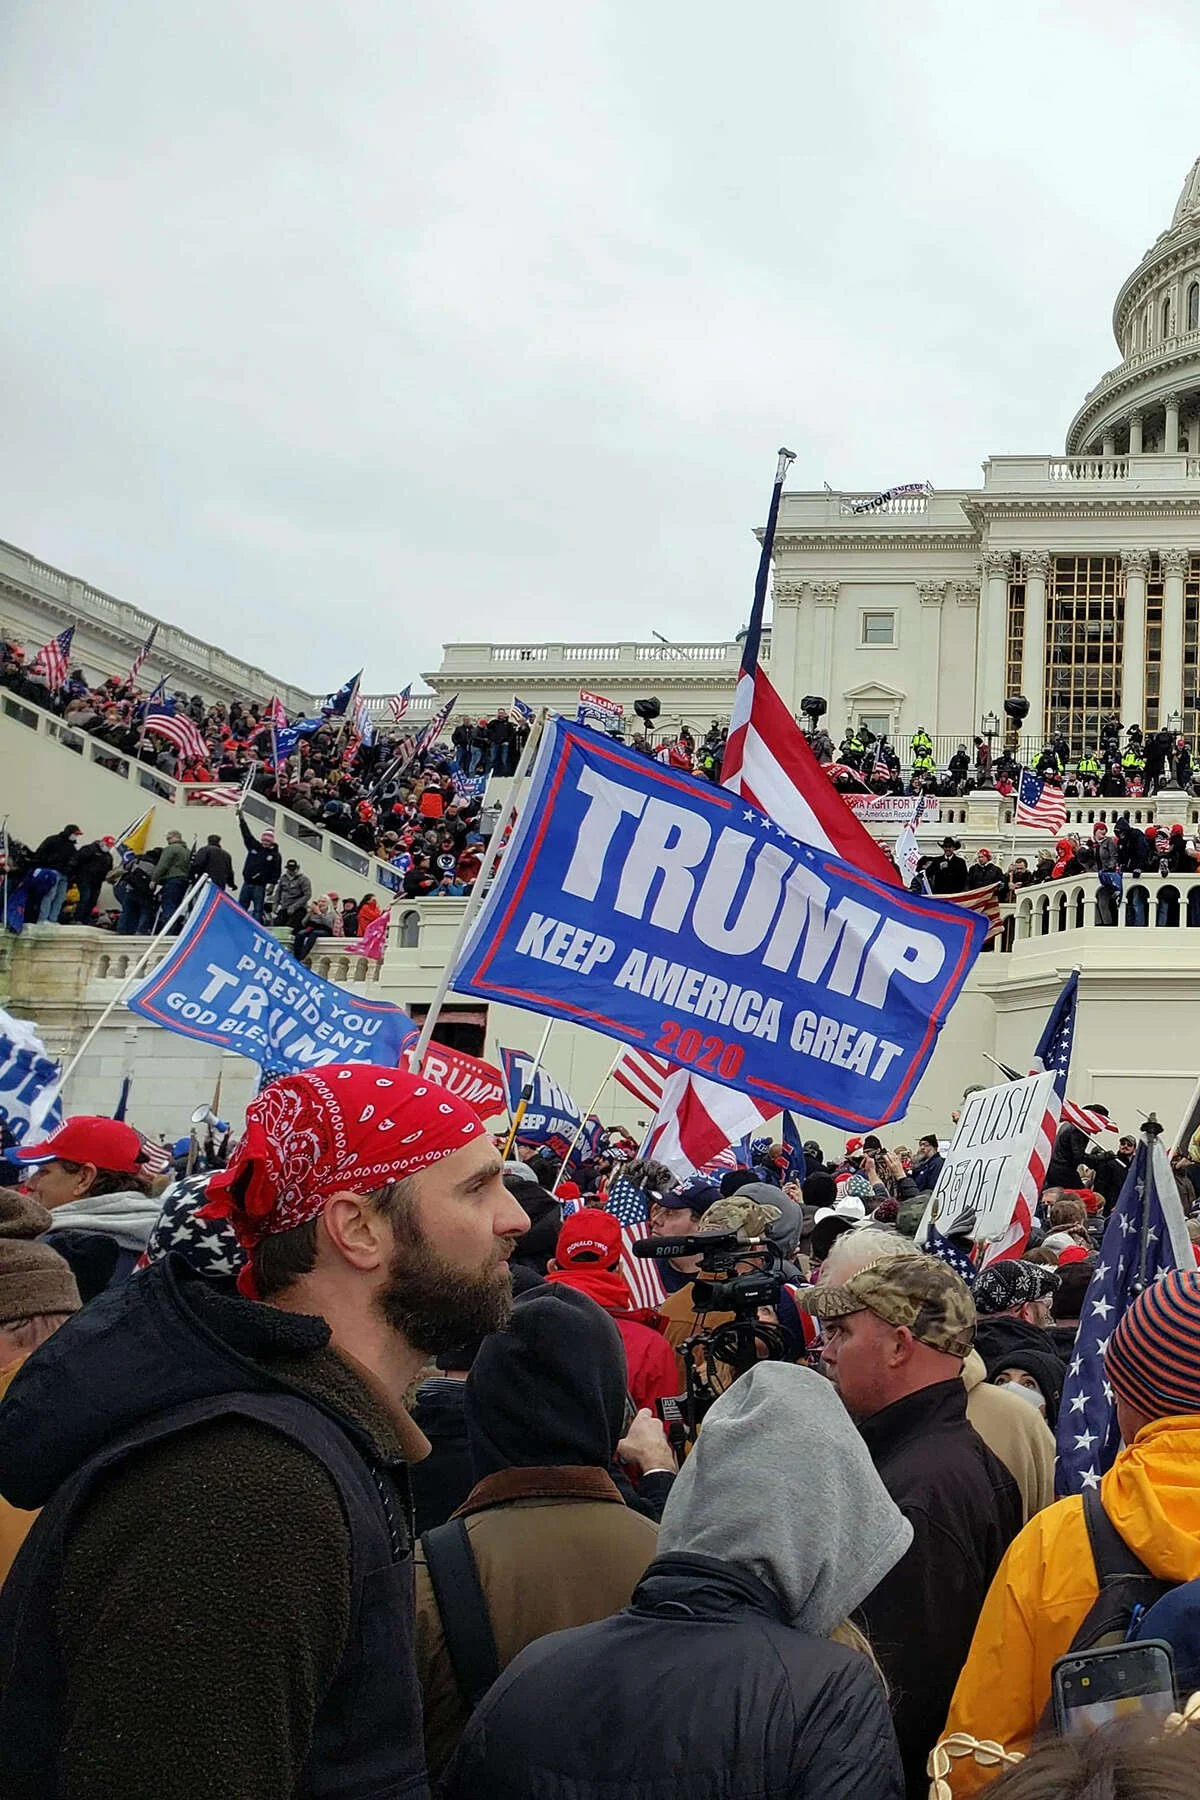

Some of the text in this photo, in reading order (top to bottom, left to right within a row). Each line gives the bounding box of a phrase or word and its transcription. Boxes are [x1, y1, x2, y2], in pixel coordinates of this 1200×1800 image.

[893, 799, 910, 809] FOR
[911, 799, 938, 809] TUMP
[561, 765, 946, 1008] TRUMP
[166, 992, 217, 1026] GOD
[200, 963, 373, 1068] TRUM
[236, 954, 371, 1054] PRESIDENT
[330, 1003, 382, 1036] YOU
[515, 913, 904, 1082] KEEP AMERICA GREAT
[653, 1021, 746, 1080] 2020
[952, 1079, 1040, 1151] FLUSH
[567, 1240, 593, 1255] DONALD
